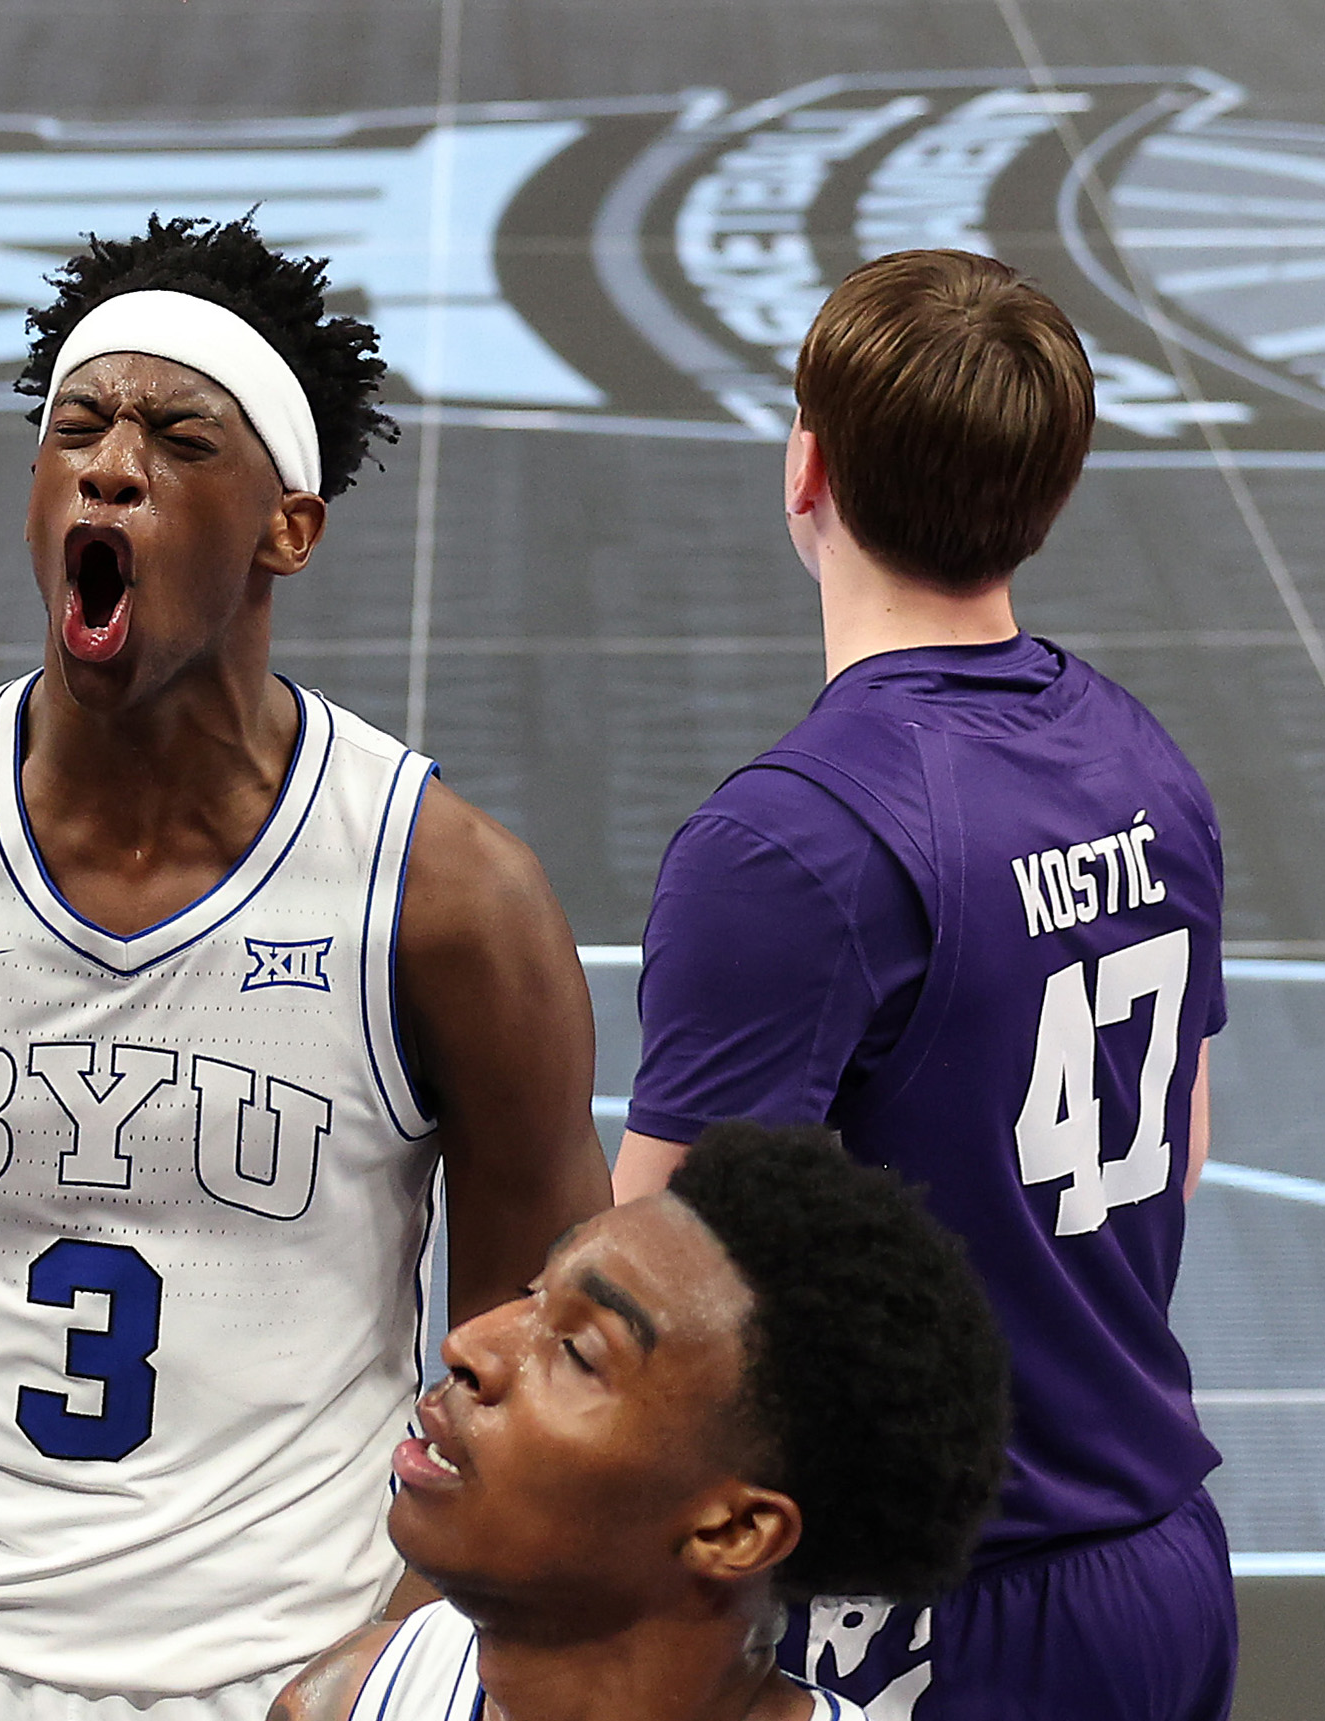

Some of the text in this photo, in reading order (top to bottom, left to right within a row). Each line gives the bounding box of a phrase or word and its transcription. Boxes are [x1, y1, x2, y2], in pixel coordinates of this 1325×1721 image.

[1011, 809, 1166, 938] KOSTIĆ
[240, 936, 334, 993] XII
[1014, 927, 1190, 1236] 47
[15, 1237, 163, 1462] 3
